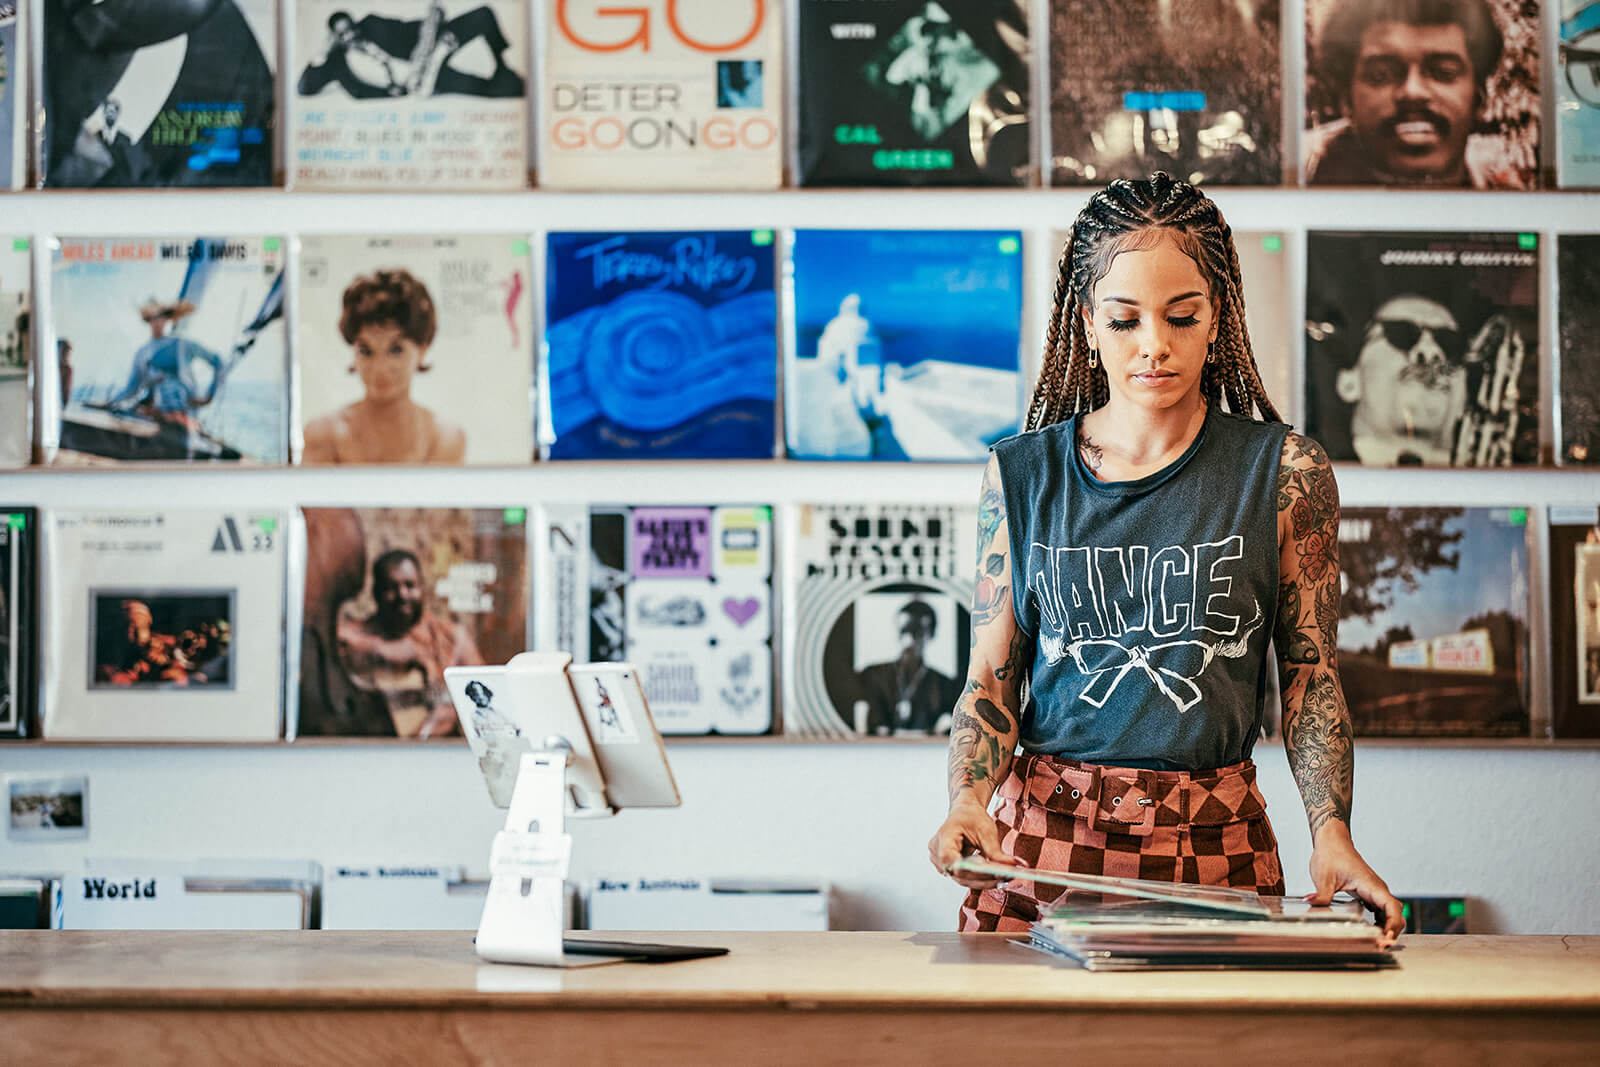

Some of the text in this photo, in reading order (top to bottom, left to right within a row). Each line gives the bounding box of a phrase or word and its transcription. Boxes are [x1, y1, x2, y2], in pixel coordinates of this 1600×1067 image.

[830, 23, 876, 40] WITH
[551, 83, 682, 112] DETER
[872, 150, 953, 170] GREEN
[1027, 535, 1243, 640] DANCE
[83, 877, 156, 898] World
